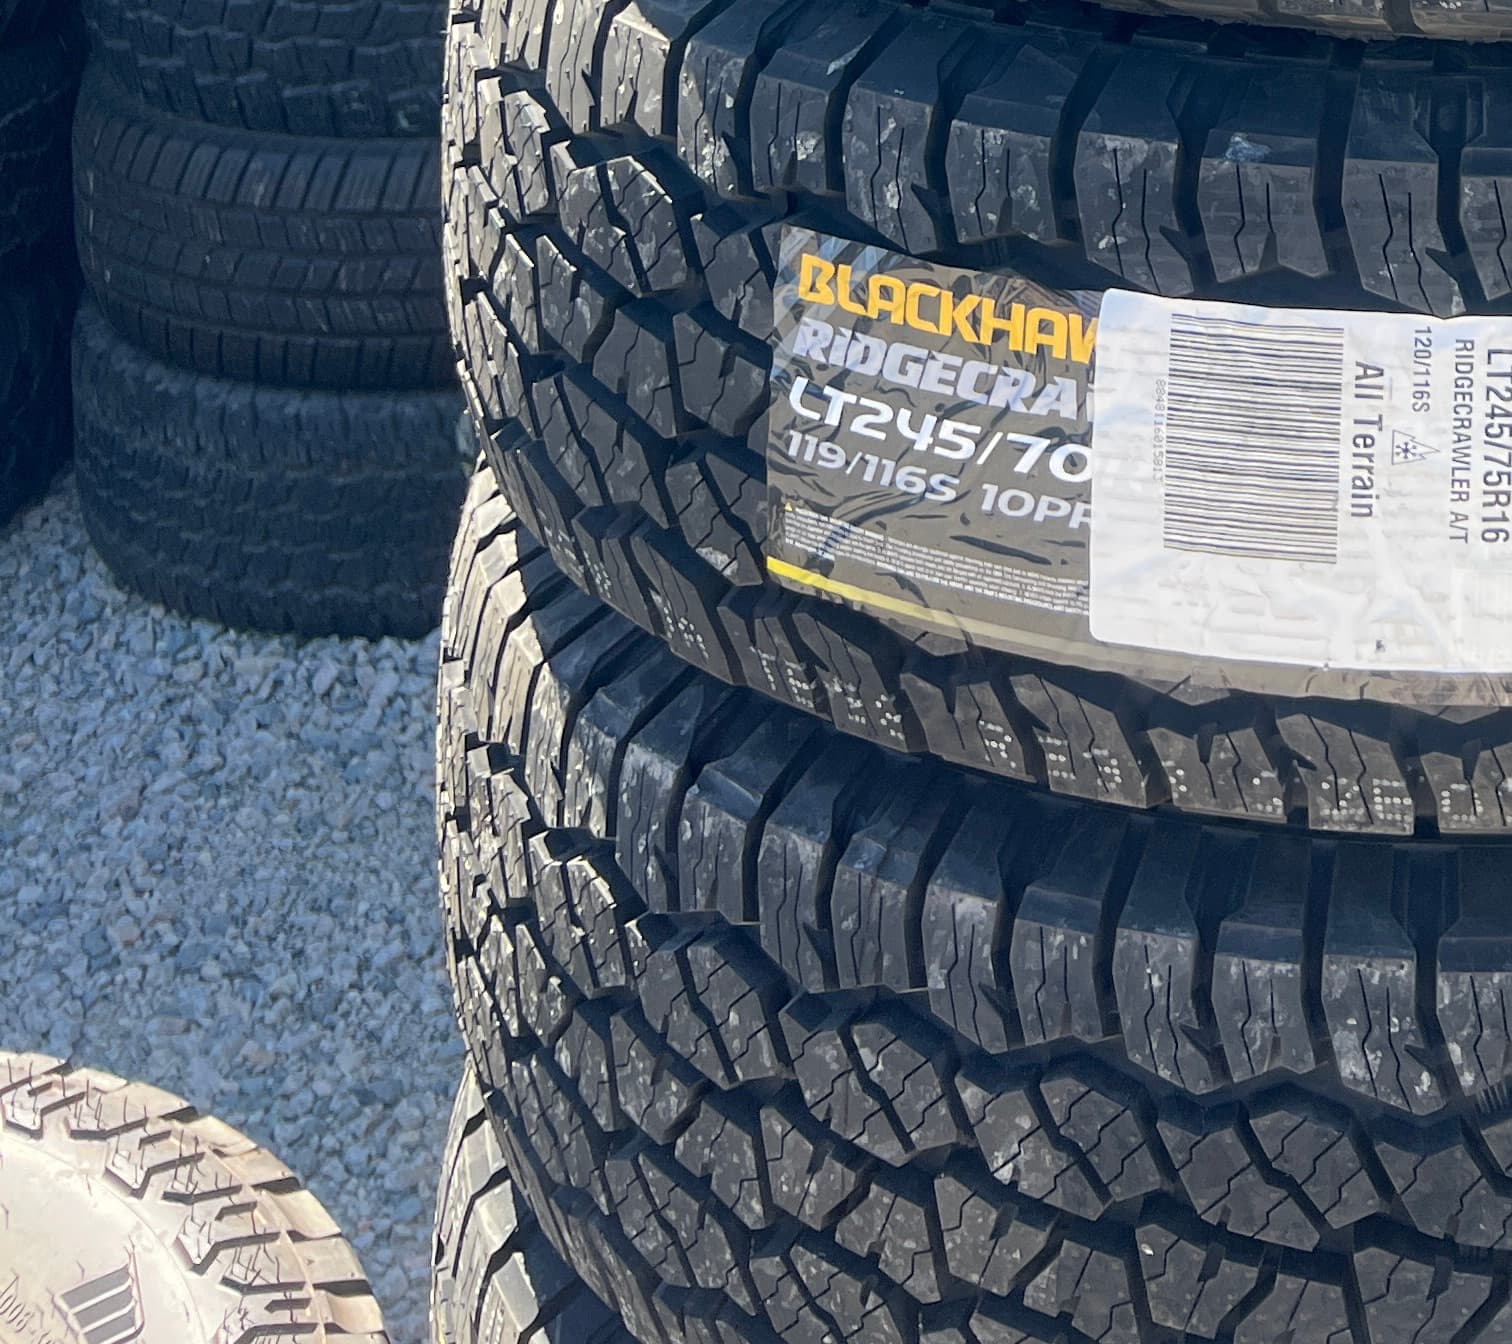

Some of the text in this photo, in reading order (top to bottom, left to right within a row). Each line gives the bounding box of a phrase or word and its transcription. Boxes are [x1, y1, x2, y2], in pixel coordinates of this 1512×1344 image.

[793, 317, 1095, 422] RIDGECRA
[1412, 327, 1432, 414] 120/116S
[786, 429, 960, 502] 119/116S
[1351, 360, 1384, 519] All Terrain
[1449, 339, 1475, 545] RIDGECRAWLER A/T
